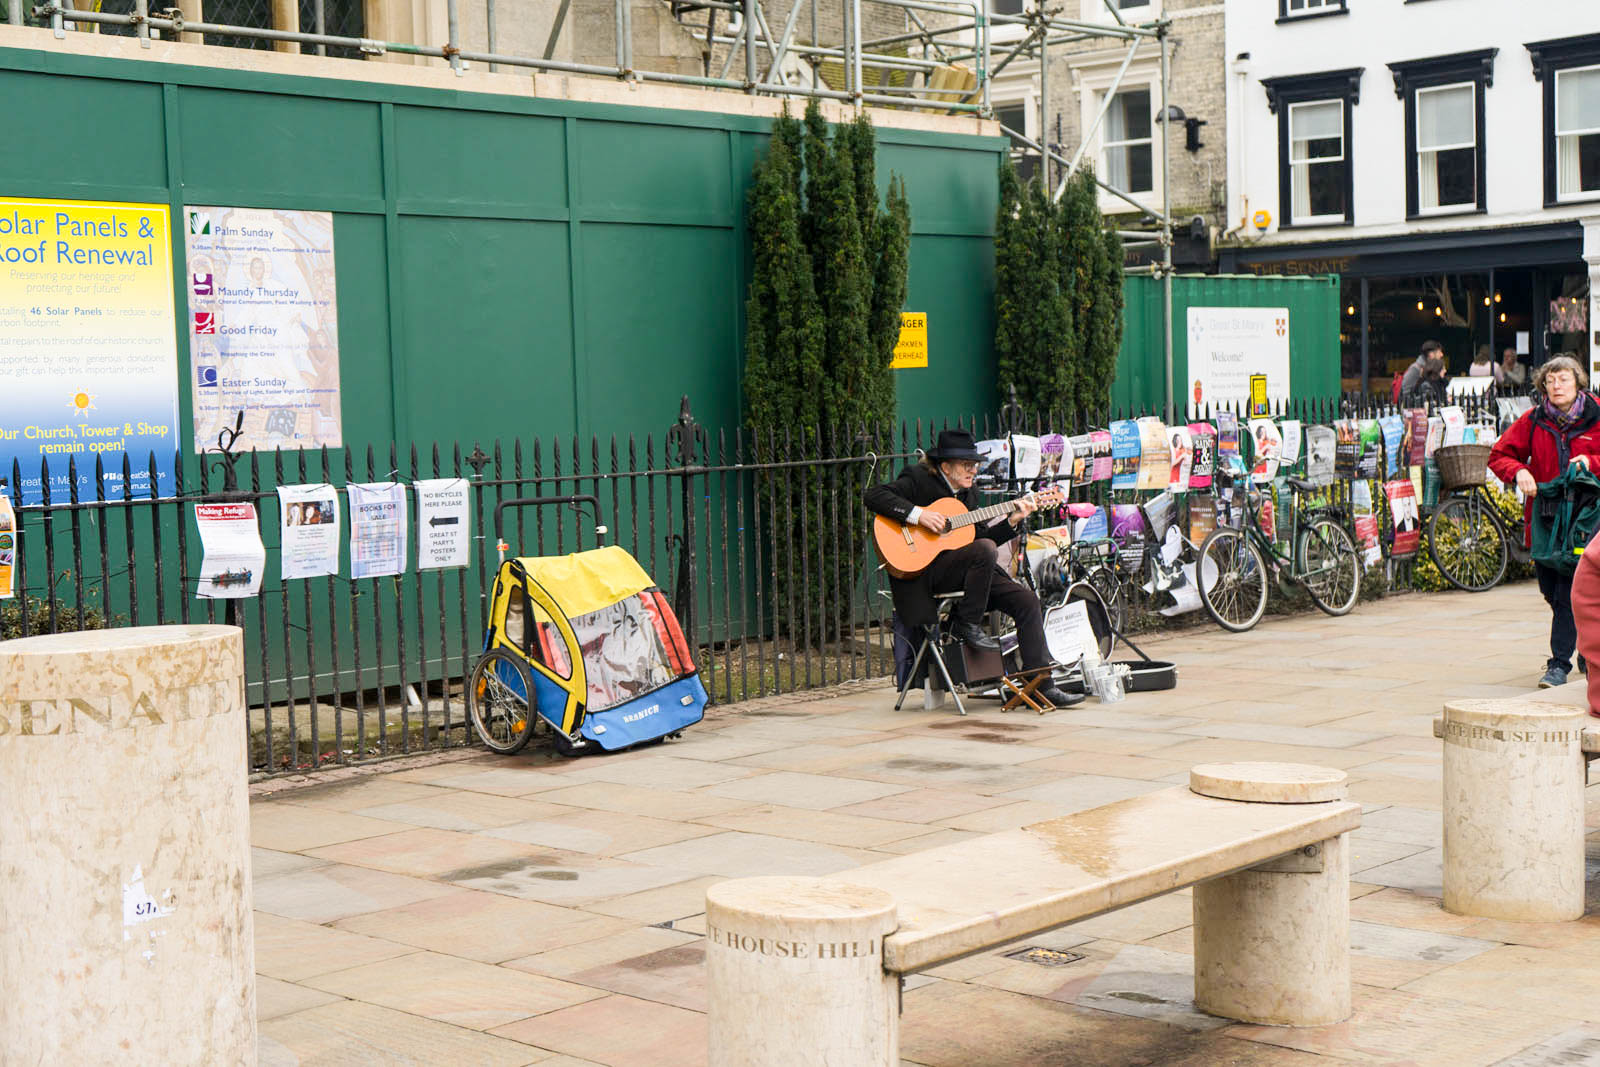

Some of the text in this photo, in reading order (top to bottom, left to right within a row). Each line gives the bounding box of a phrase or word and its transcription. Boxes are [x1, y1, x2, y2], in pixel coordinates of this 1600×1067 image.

[56, 212, 128, 238] Panels
[138, 216, 154, 238] &
[215, 226, 274, 239] Palm Sunday
[0, 240, 153, 266] oof Renewal
[10, 269, 58, 282] Preserving
[118, 272, 136, 282] and
[26, 284, 73, 296] protecting
[218, 287, 299, 298] Maundy Thursday
[30, 307, 42, 316] 46
[46, 306, 70, 316] Solar
[74, 306, 103, 316] Panels
[902, 319, 924, 328] NGER
[219, 324, 277, 337] Good Friday
[222, 377, 287, 389] Easter Sunday
[24, 423, 78, 440] Church,
[78, 424, 120, 438] Tower
[124, 422, 134, 436] &
[137, 421, 169, 438] Shop
[39, 437, 126, 454] remain open!
[20, 476, 41, 488] reat
[429, 531, 449, 539] GREAT
[430, 547, 457, 555] POSTERS
[727, 931, 808, 959] HOUSE
